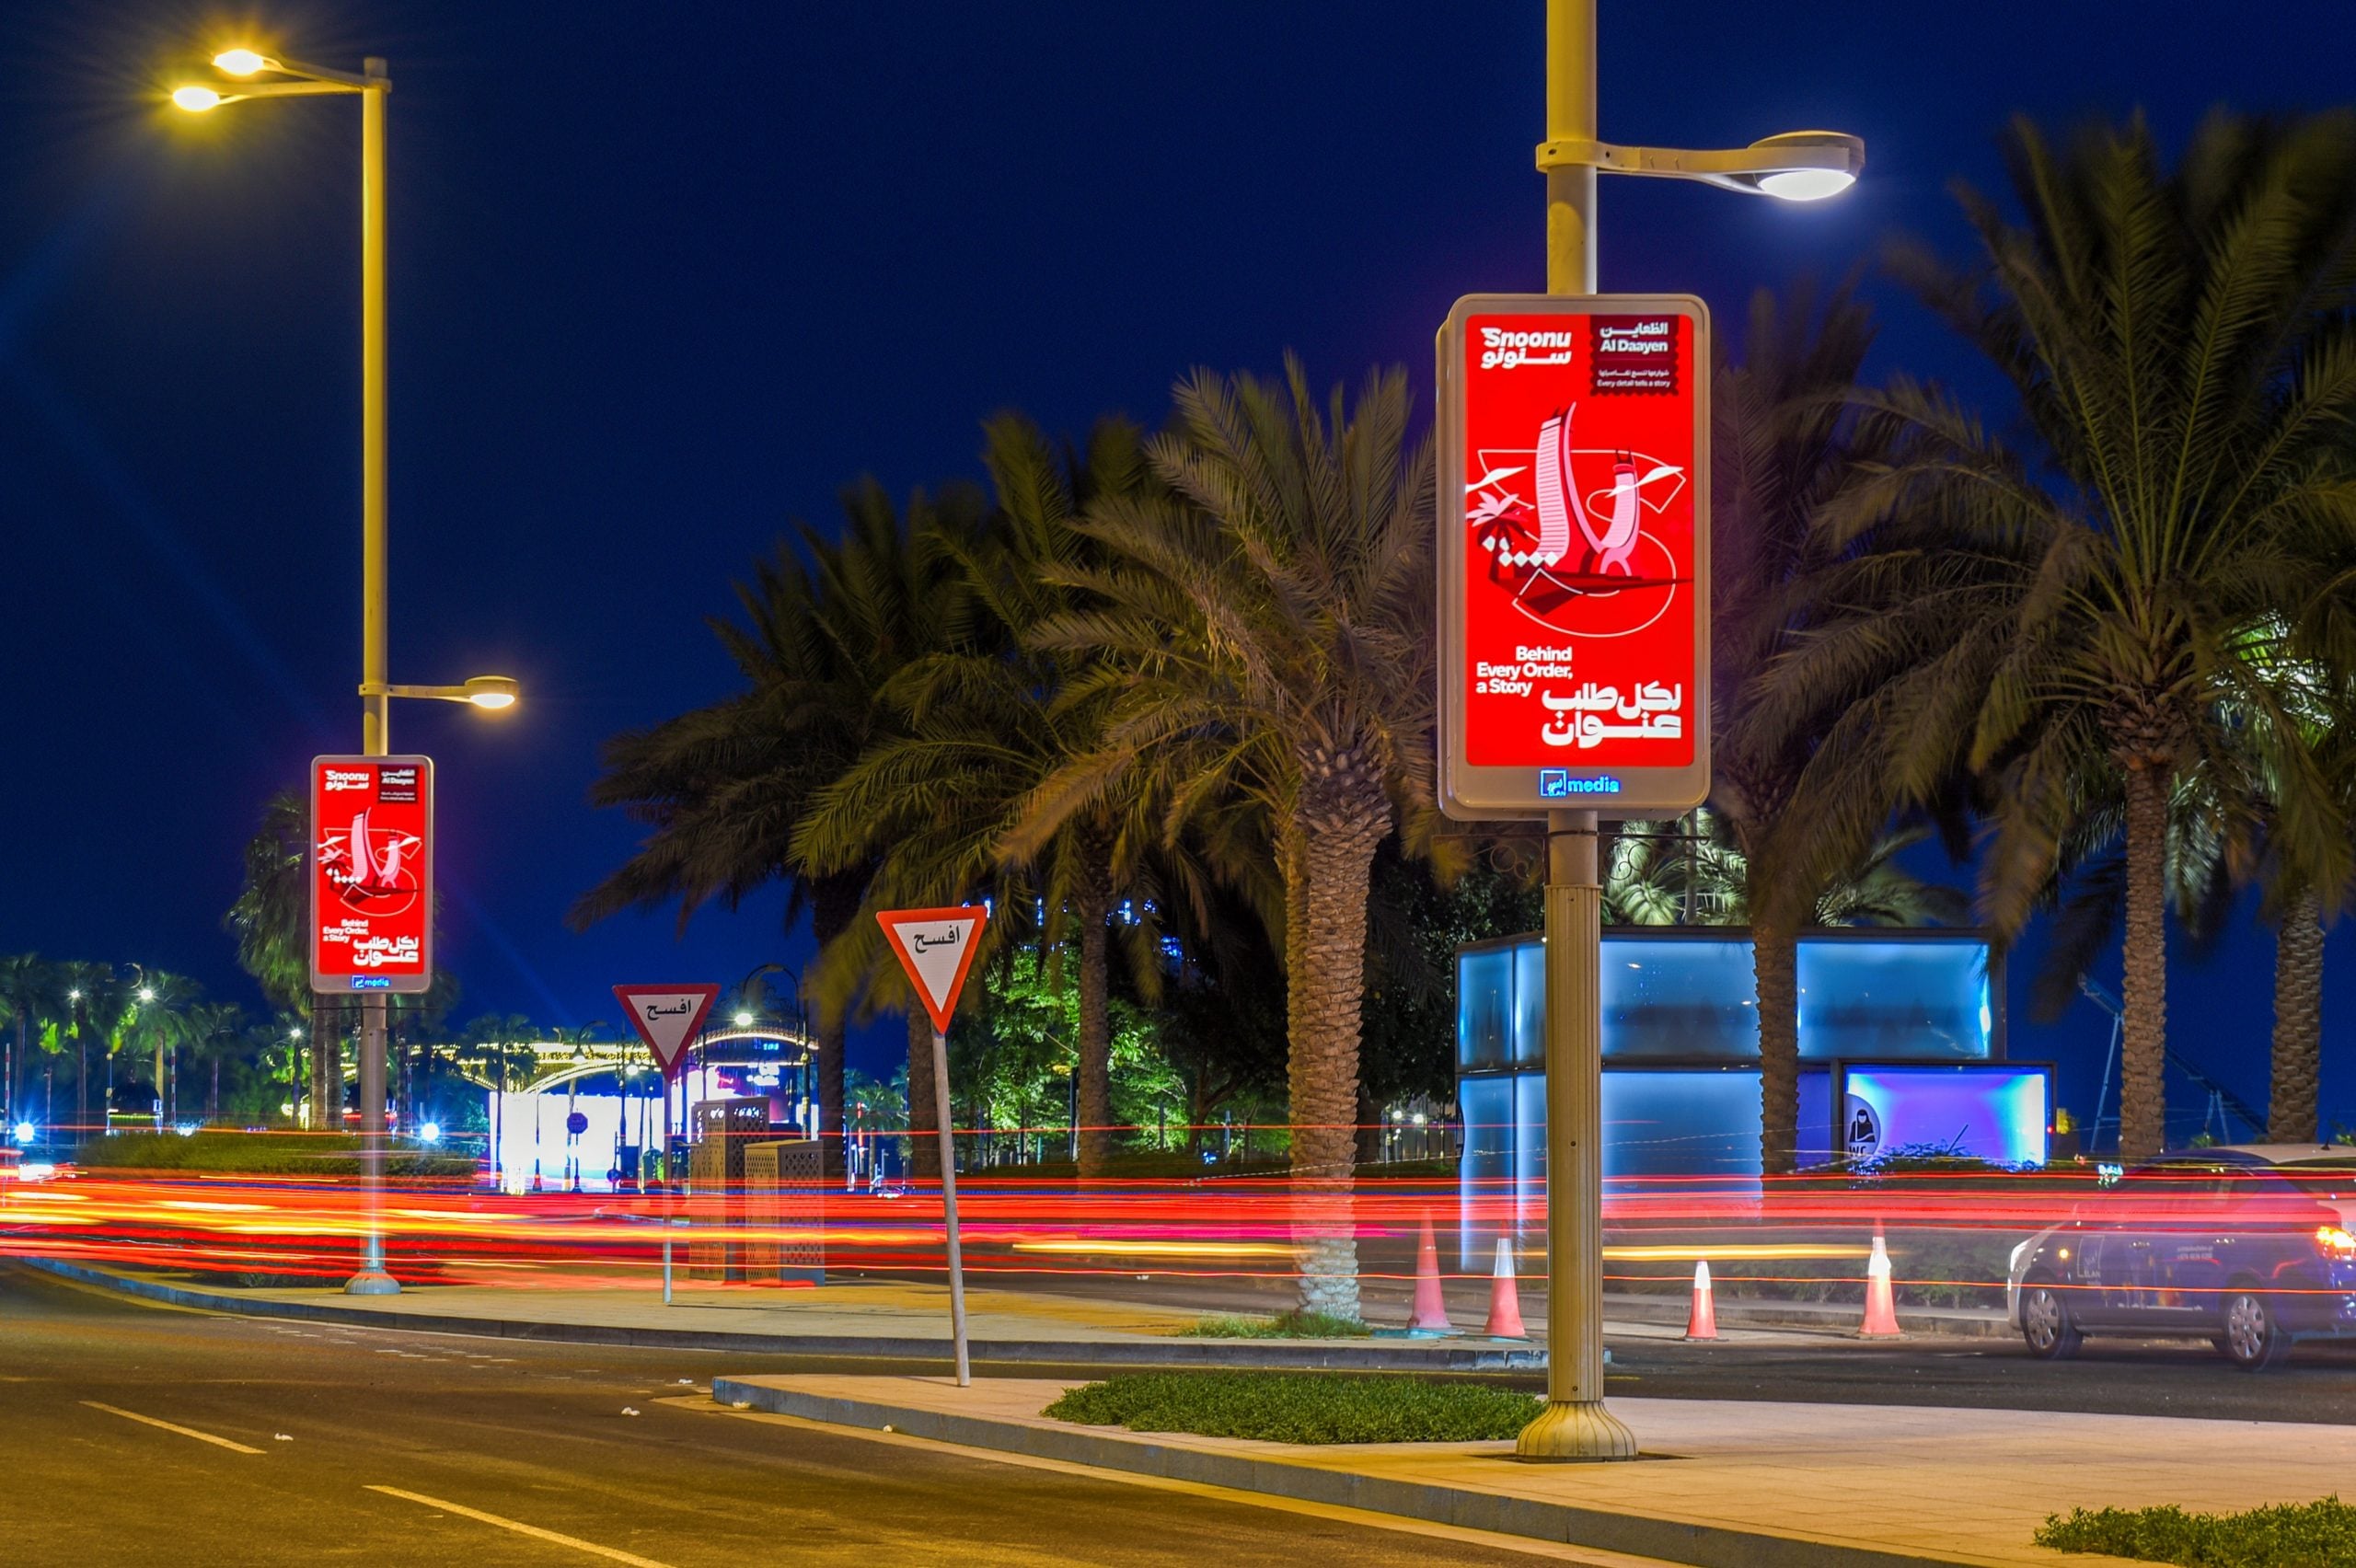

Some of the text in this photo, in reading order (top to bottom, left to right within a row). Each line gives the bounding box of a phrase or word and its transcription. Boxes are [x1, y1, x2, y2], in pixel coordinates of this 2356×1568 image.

[1480, 327, 1572, 348] Snoonu
[1600, 340, 1669, 354] Al Daayen
[1480, 347, 1572, 369] سنونو
[1597, 379, 1615, 387] Every
[1516, 646, 1572, 661] Behind
[1477, 662, 1573, 681] Every Order,
[1476, 678, 1533, 697] a Story
[1542, 681, 1681, 720] لكل طلب
[1542, 710, 1681, 748] عنوان
[325, 769, 369, 780] Snoonu
[1568, 777, 1619, 792] media
[323, 926, 344, 936] Every
[914, 925, 959, 953] افسح
[353, 936, 419, 953] لكل طلب
[646, 998, 690, 1020] افسح
